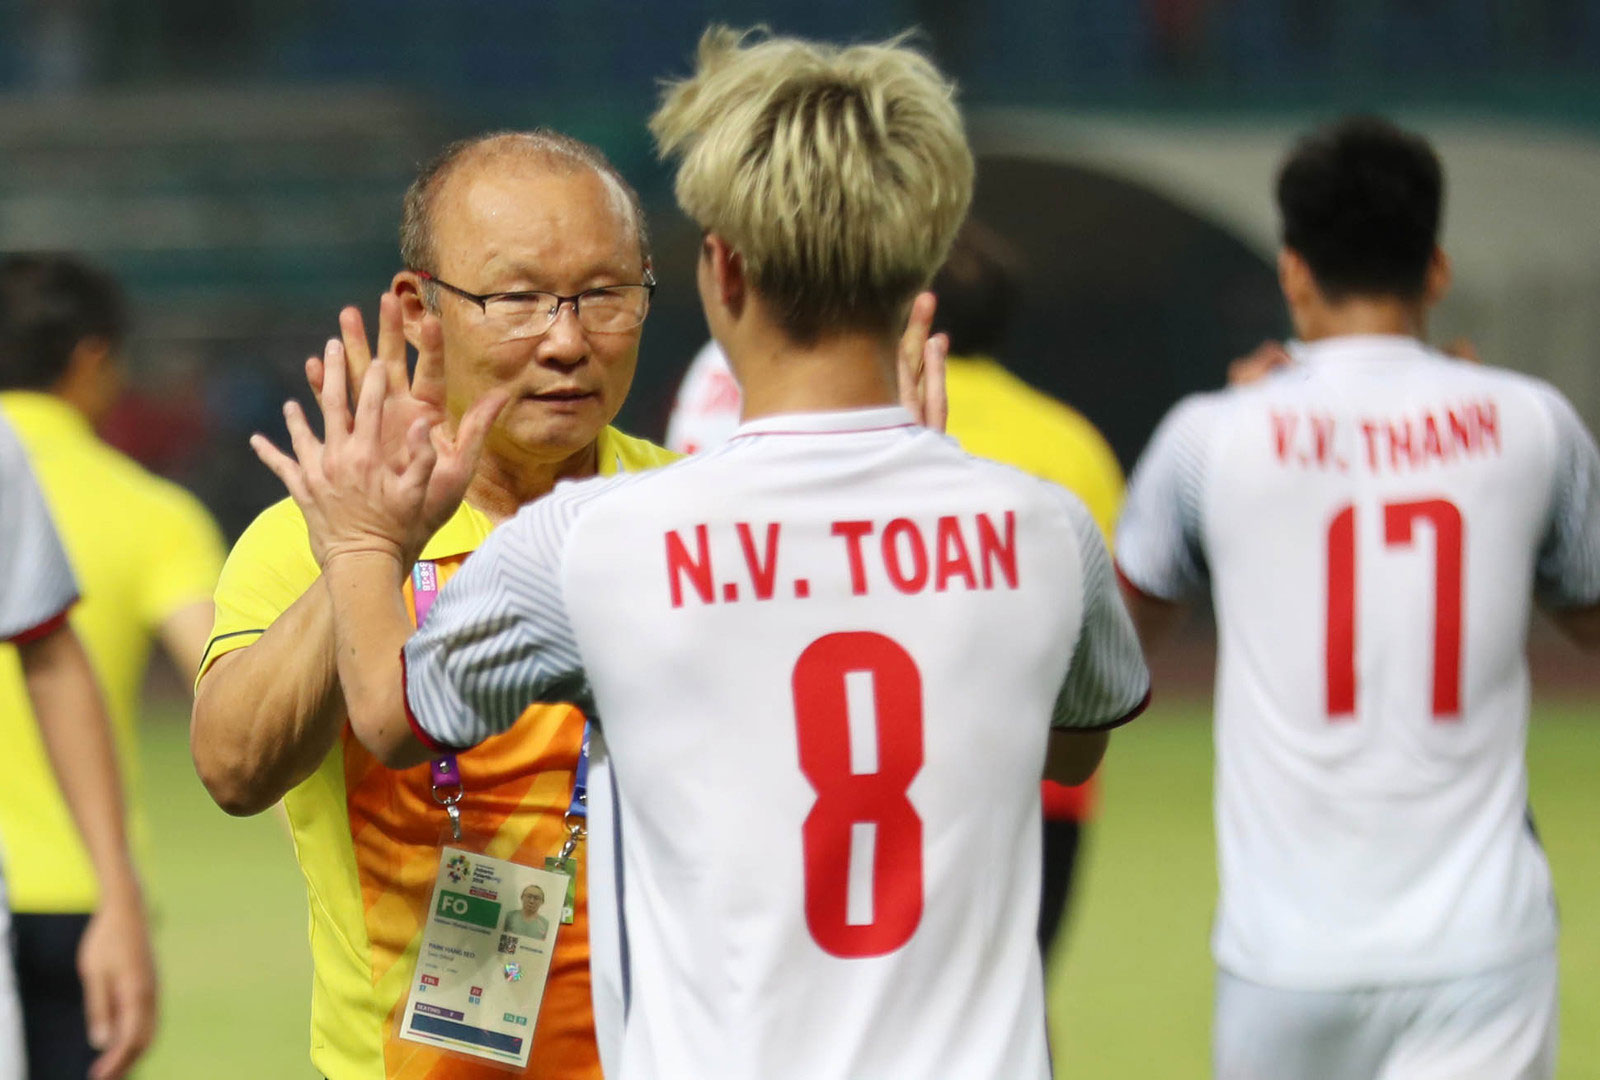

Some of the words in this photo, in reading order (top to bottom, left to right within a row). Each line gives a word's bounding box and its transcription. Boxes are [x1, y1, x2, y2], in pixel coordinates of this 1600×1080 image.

[1361, 402, 1499, 474] THANH
[664, 521, 809, 608] N.V.
[831, 510, 1019, 596] TOAN
[1326, 499, 1462, 717] 17
[791, 630, 925, 960] 8
[442, 895, 468, 915] FO
